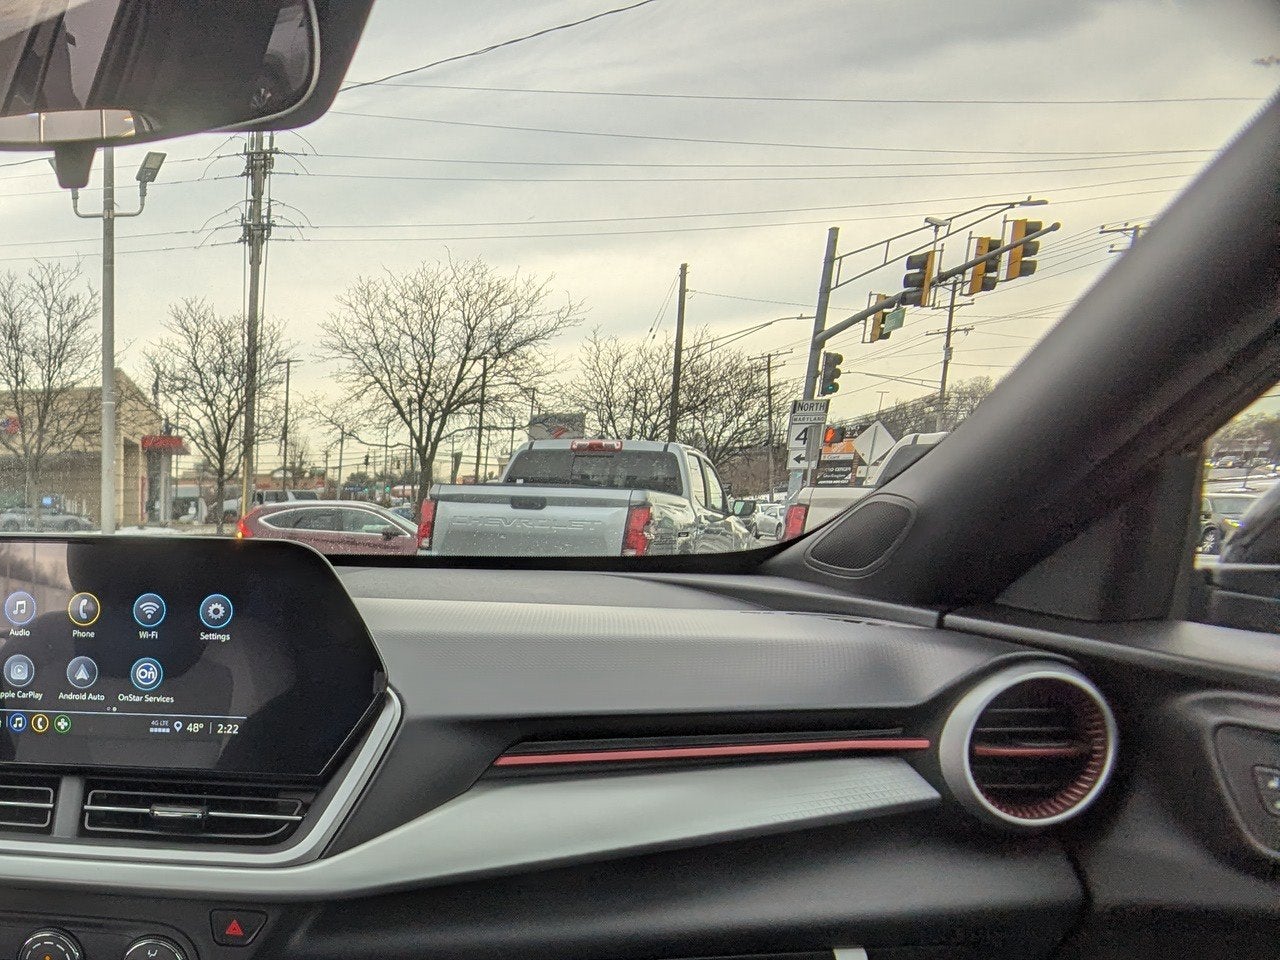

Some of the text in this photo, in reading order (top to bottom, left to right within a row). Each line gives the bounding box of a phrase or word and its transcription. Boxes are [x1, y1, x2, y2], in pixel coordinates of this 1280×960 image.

[798, 403, 826, 411] NORTH
[451, 516, 602, 530] CHEVROLET
[9, 629, 31, 637] Audio
[72, 630, 95, 638] Phone
[139, 631, 158, 639] Wi-Fi
[200, 632, 230, 641] Settings
[16, 691, 43, 700] CarPlay
[58, 692, 105, 701] Android Auto
[118, 694, 174, 703] OnStar Services
[186, 723, 204, 732] 48°
[217, 724, 239, 734] 2:22
